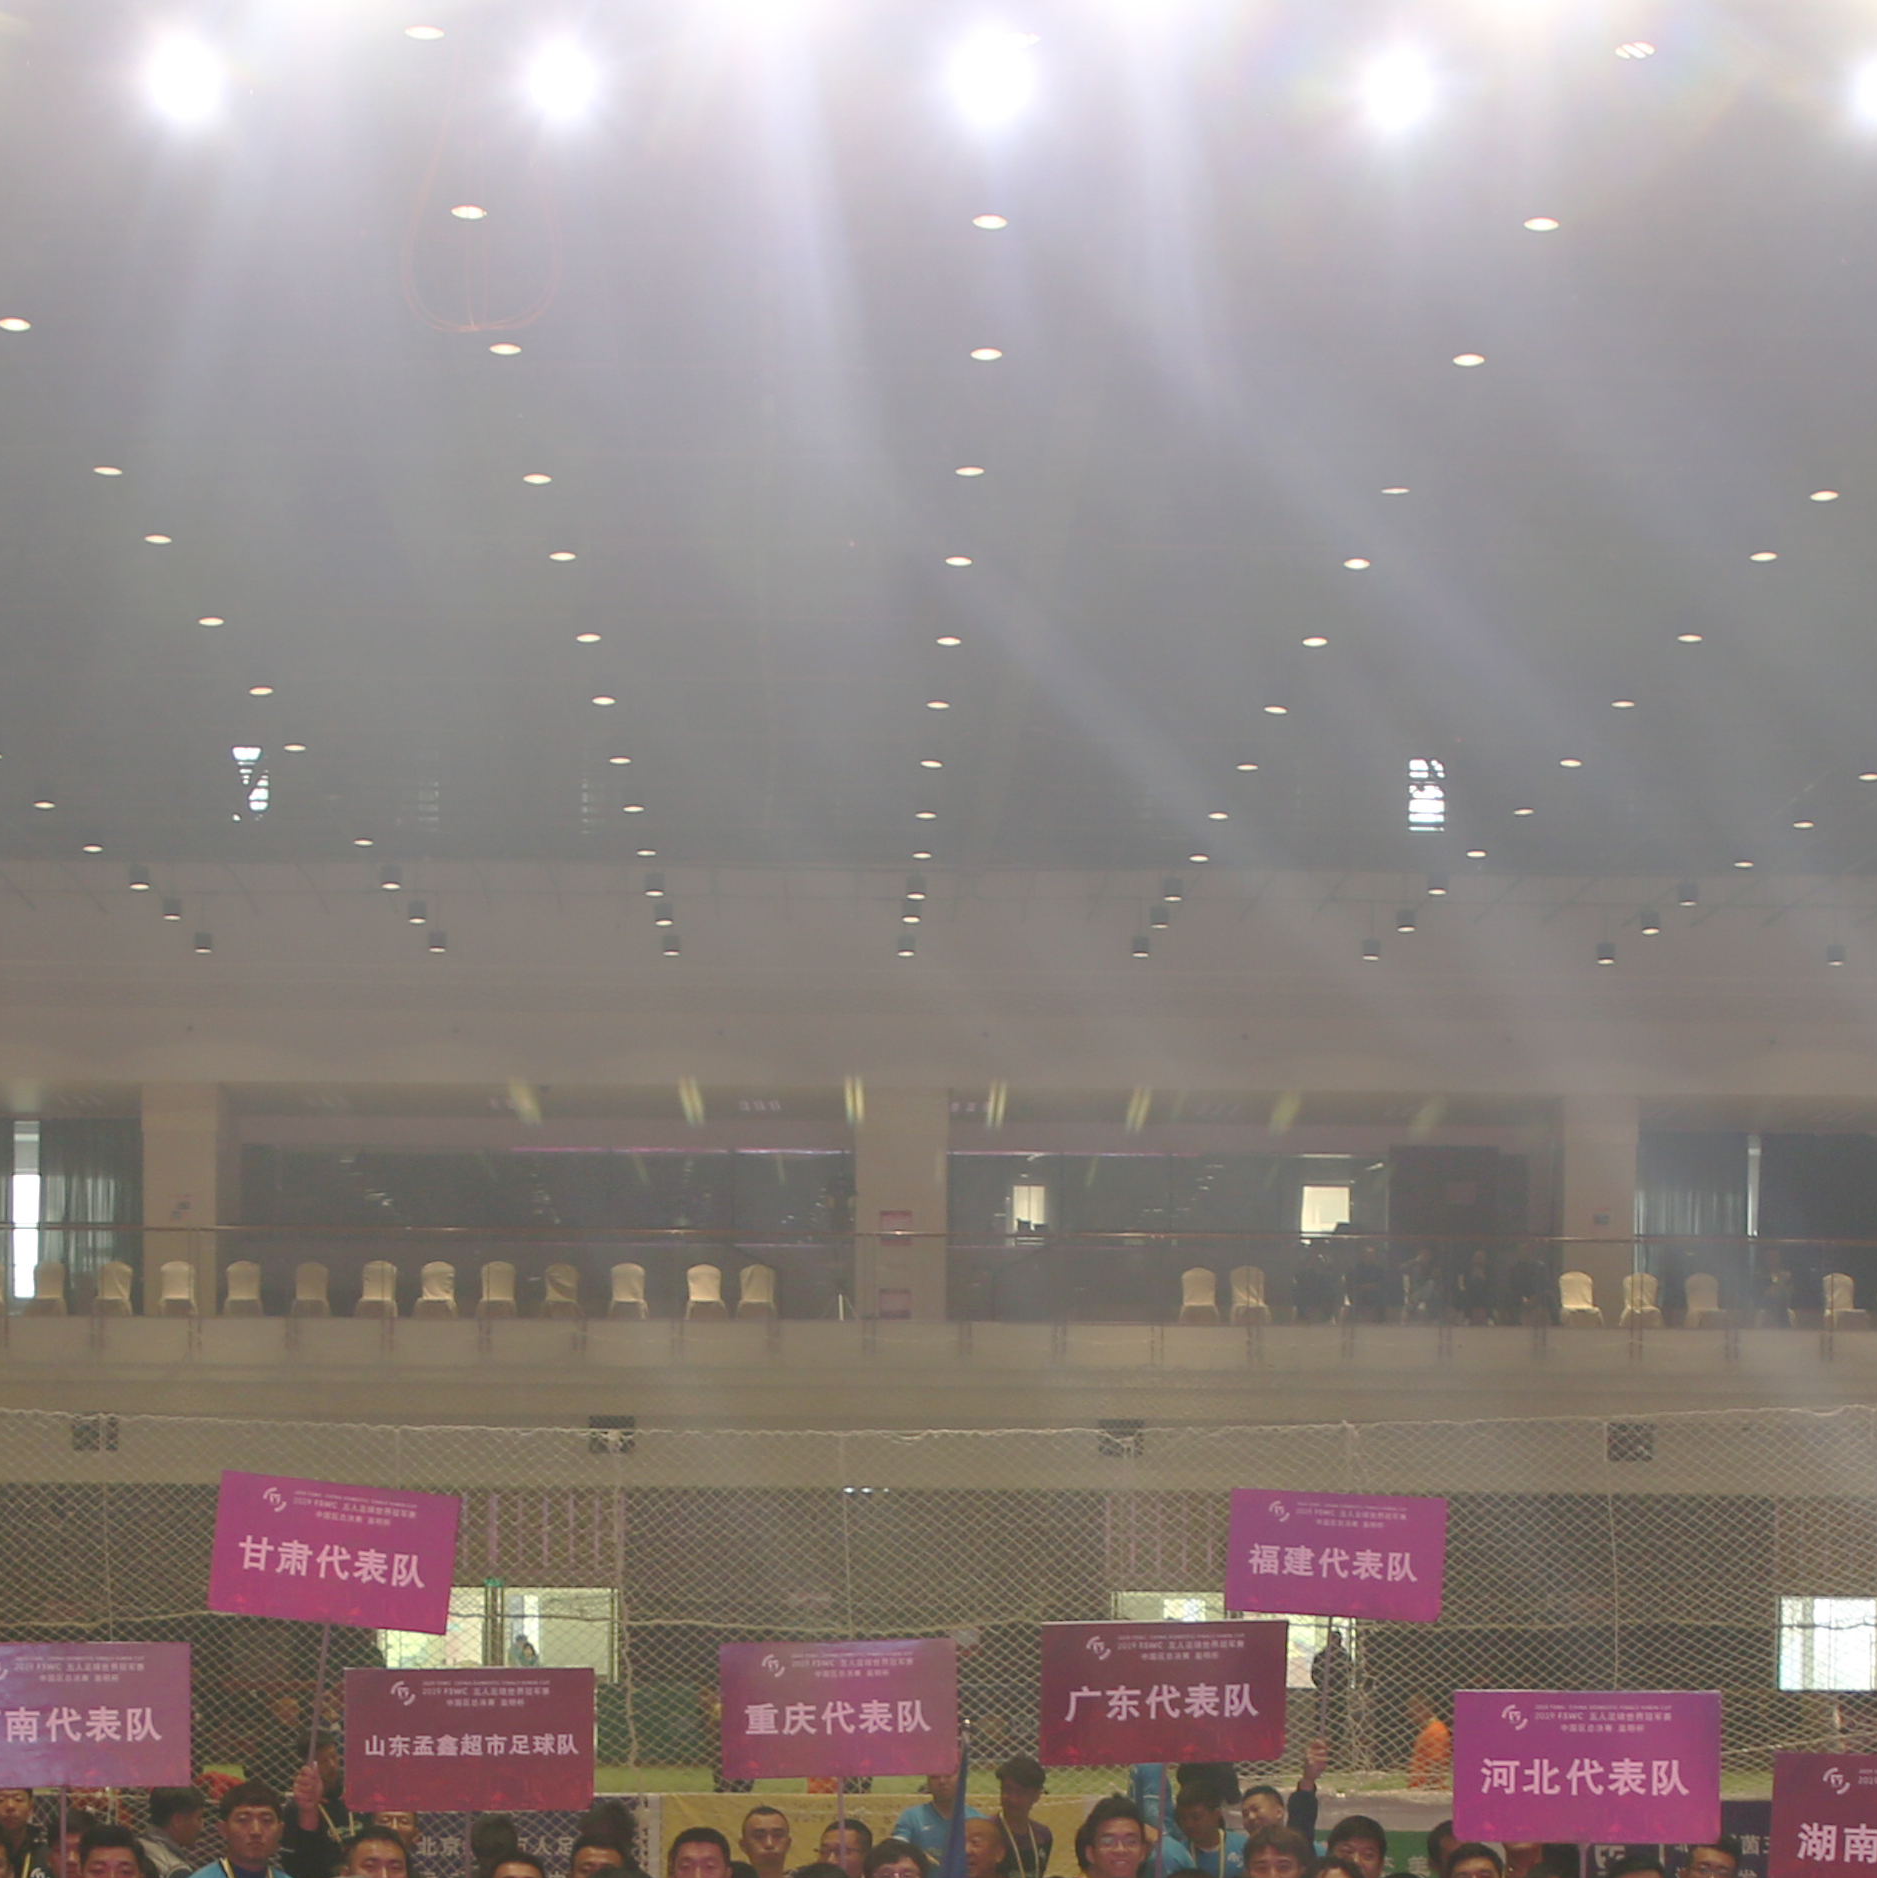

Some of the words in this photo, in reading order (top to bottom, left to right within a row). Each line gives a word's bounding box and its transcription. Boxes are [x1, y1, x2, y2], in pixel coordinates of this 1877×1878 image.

[238, 1534, 425, 1589] 甘肃代表队
[1247, 1542, 1418, 1583] 福建代表队
[744, 1699, 932, 1736] 重庆代表队
[1064, 1682, 1259, 1722] 广东代表队
[1480, 1757, 1690, 1796] 河北代表队
